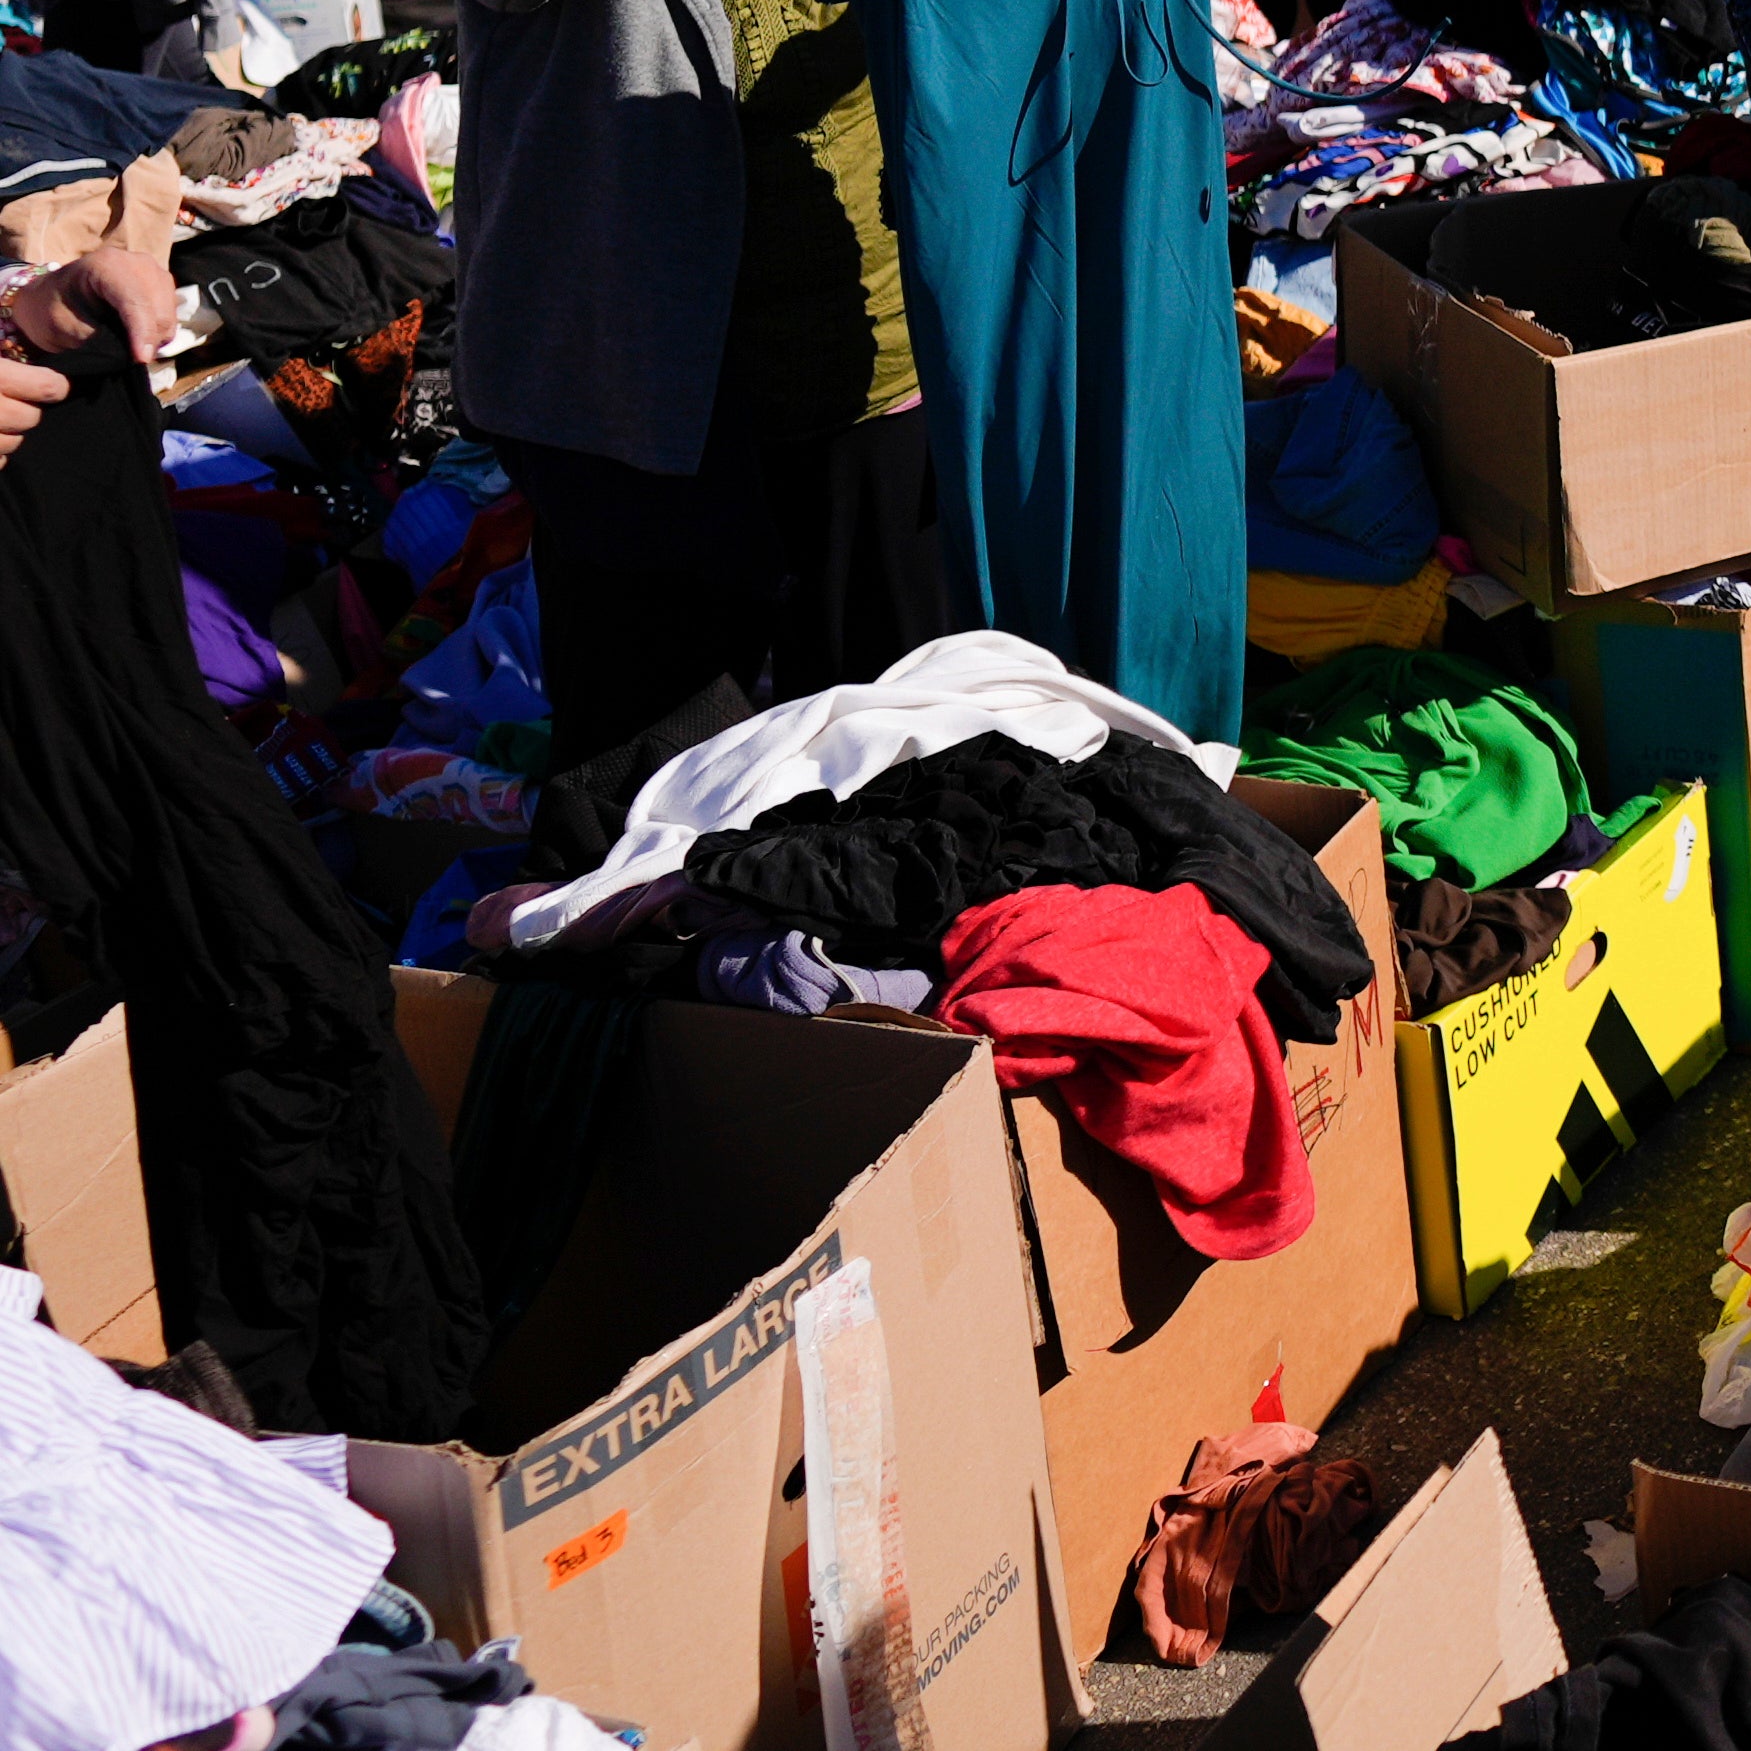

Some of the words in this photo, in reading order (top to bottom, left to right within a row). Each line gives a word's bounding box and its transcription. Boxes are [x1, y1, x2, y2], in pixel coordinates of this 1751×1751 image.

[1455, 1029, 1497, 1090] LOW
[1504, 988, 1539, 1042] CUT
[521, 1373, 694, 1509] EXTRA
[553, 1545, 590, 1577] Bed
[596, 1527, 615, 1554] 3
[943, 1551, 1013, 1632] PACKING
[914, 1565, 1022, 1694] MOVING.COM
